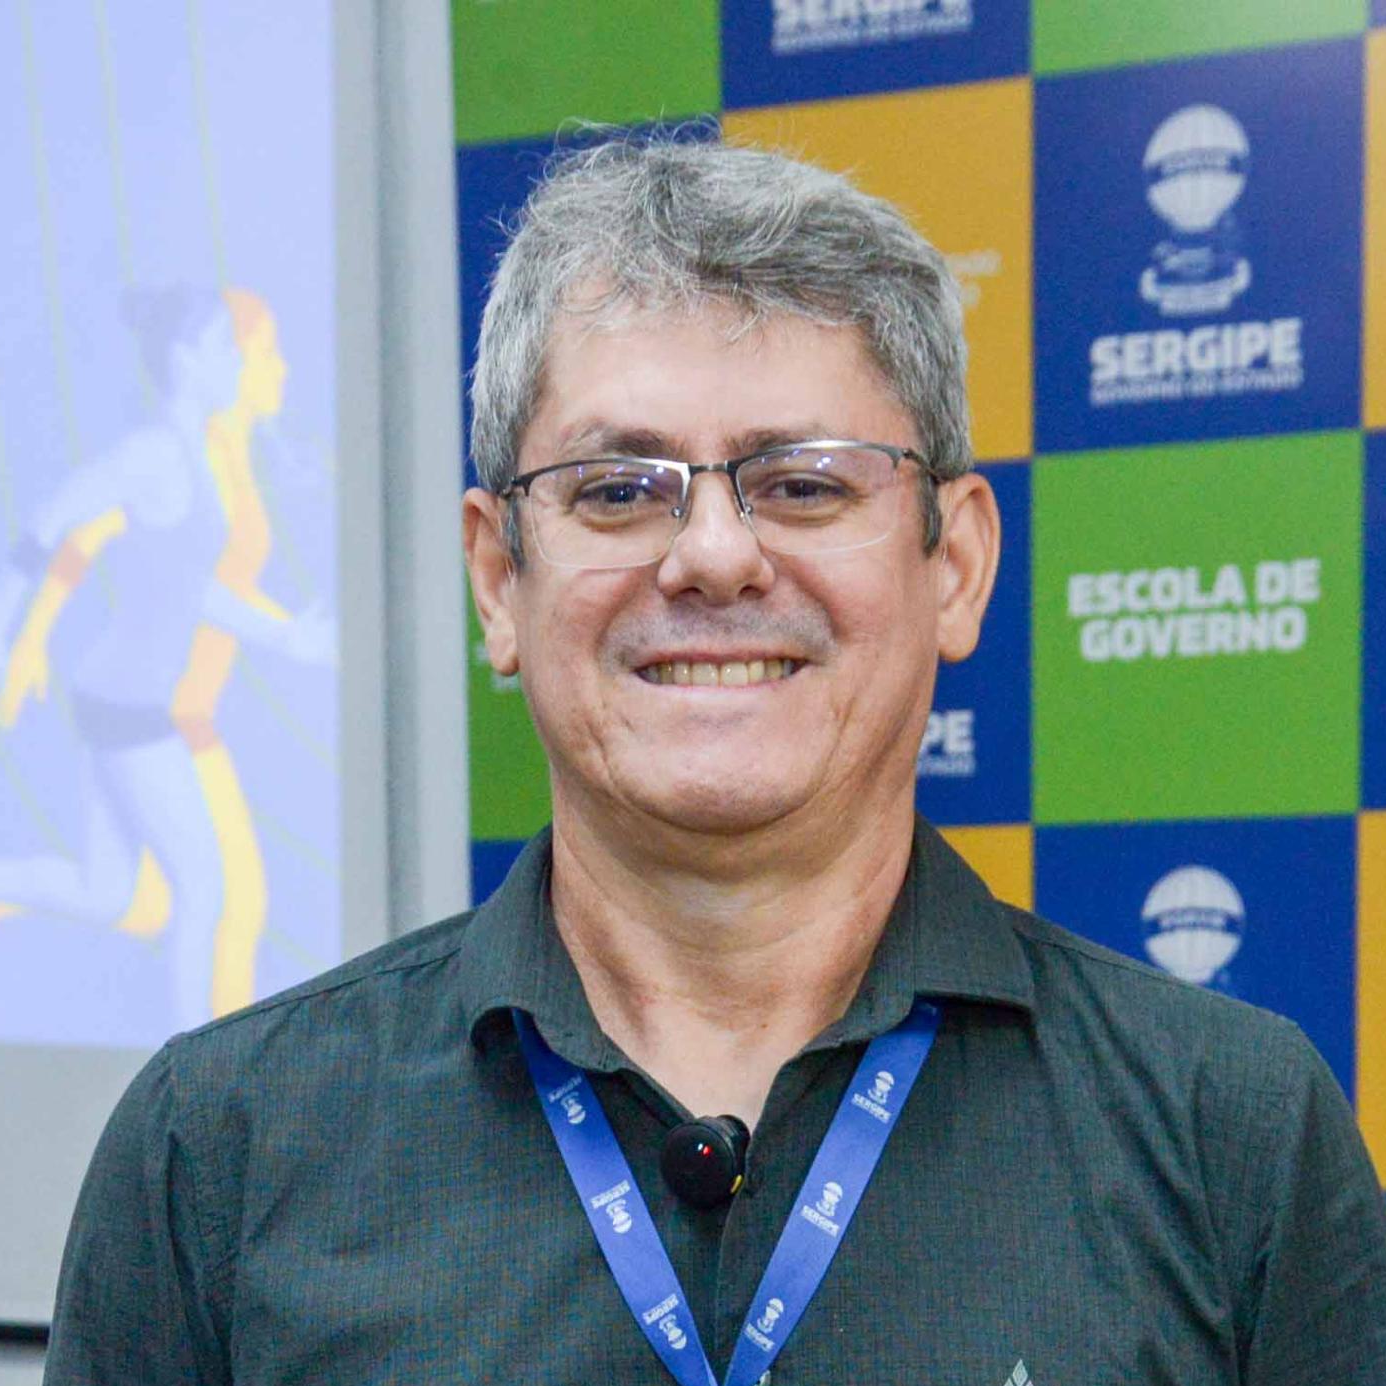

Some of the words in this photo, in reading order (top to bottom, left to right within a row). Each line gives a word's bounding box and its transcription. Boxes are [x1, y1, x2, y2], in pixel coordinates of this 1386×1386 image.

[1090, 319, 1302, 381] SERGIPE
[1067, 566, 1246, 617] ESCOLA
[1255, 558, 1321, 603] DE
[1079, 607, 1308, 662] GOVERNO
